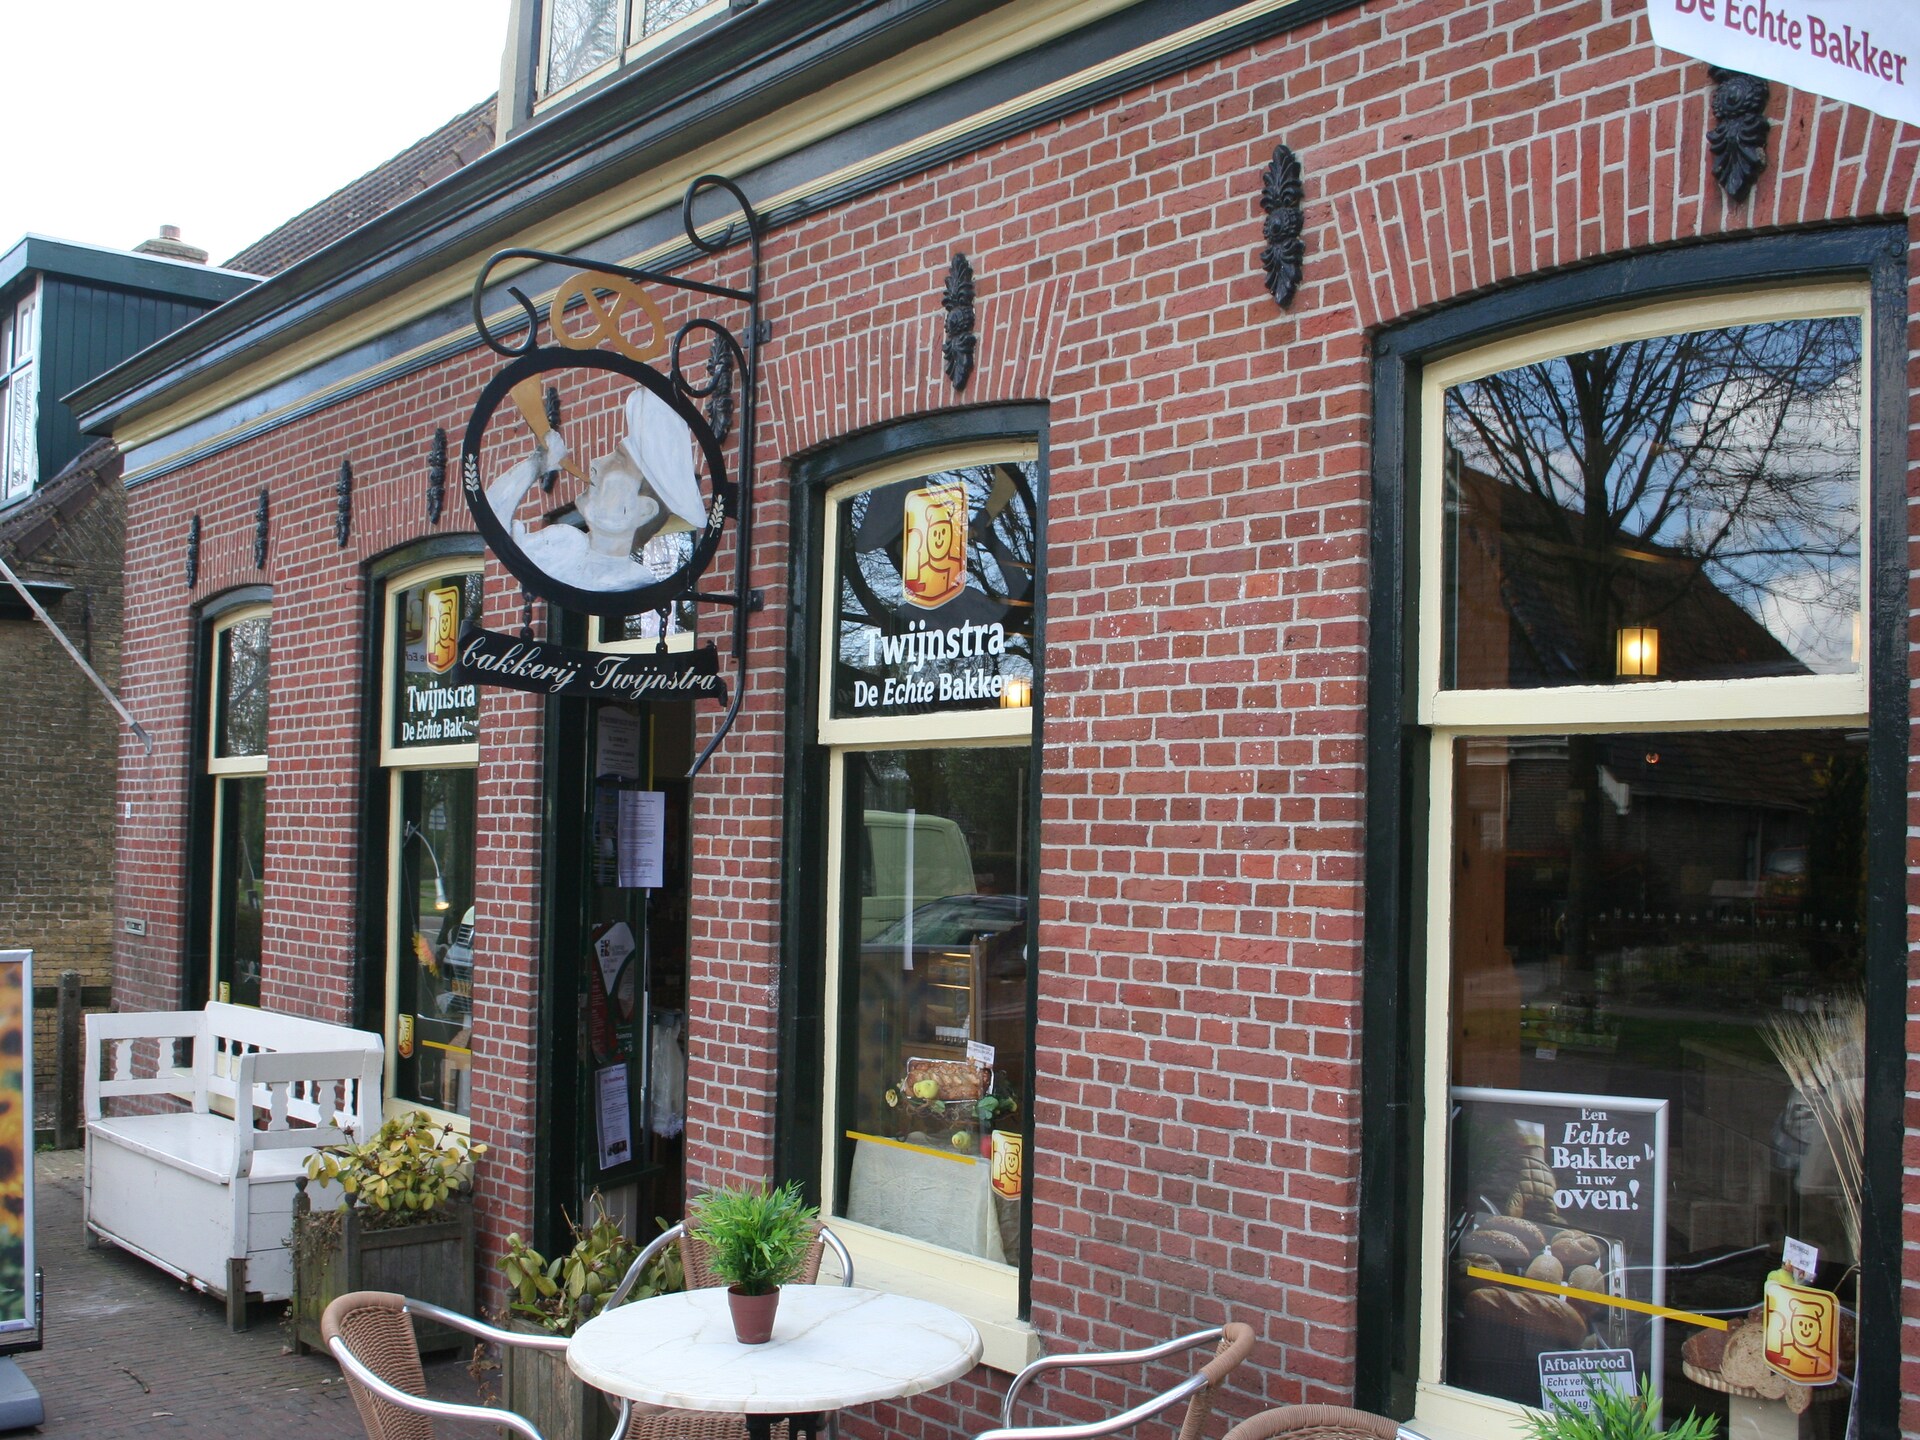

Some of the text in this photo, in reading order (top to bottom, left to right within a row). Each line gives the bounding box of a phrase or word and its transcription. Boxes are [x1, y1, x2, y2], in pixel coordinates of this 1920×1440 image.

[1724, 0, 1802, 50] Echte
[1806, 14, 1907, 86] Bakker
[863, 619, 1005, 672] Twijnstra
[589, 655, 716, 700] Twijnstra
[854, 668, 1013, 708] De Echte Bakker
[407, 681, 476, 718] Twijnstra
[402, 721, 415, 741] De
[416, 718, 442, 740] Echte
[1581, 1108, 1608, 1121] Een
[1562, 1122, 1630, 1146] Echte
[1550, 1146, 1641, 1170] Bakker
[1576, 1170, 1617, 1186] in uw
[1552, 1179, 1640, 1211] oven!
[1544, 1355, 1627, 1372] Afbakbrood
[1547, 1377, 1568, 1387] Echt
[1551, 1388, 1585, 1398] rokant
